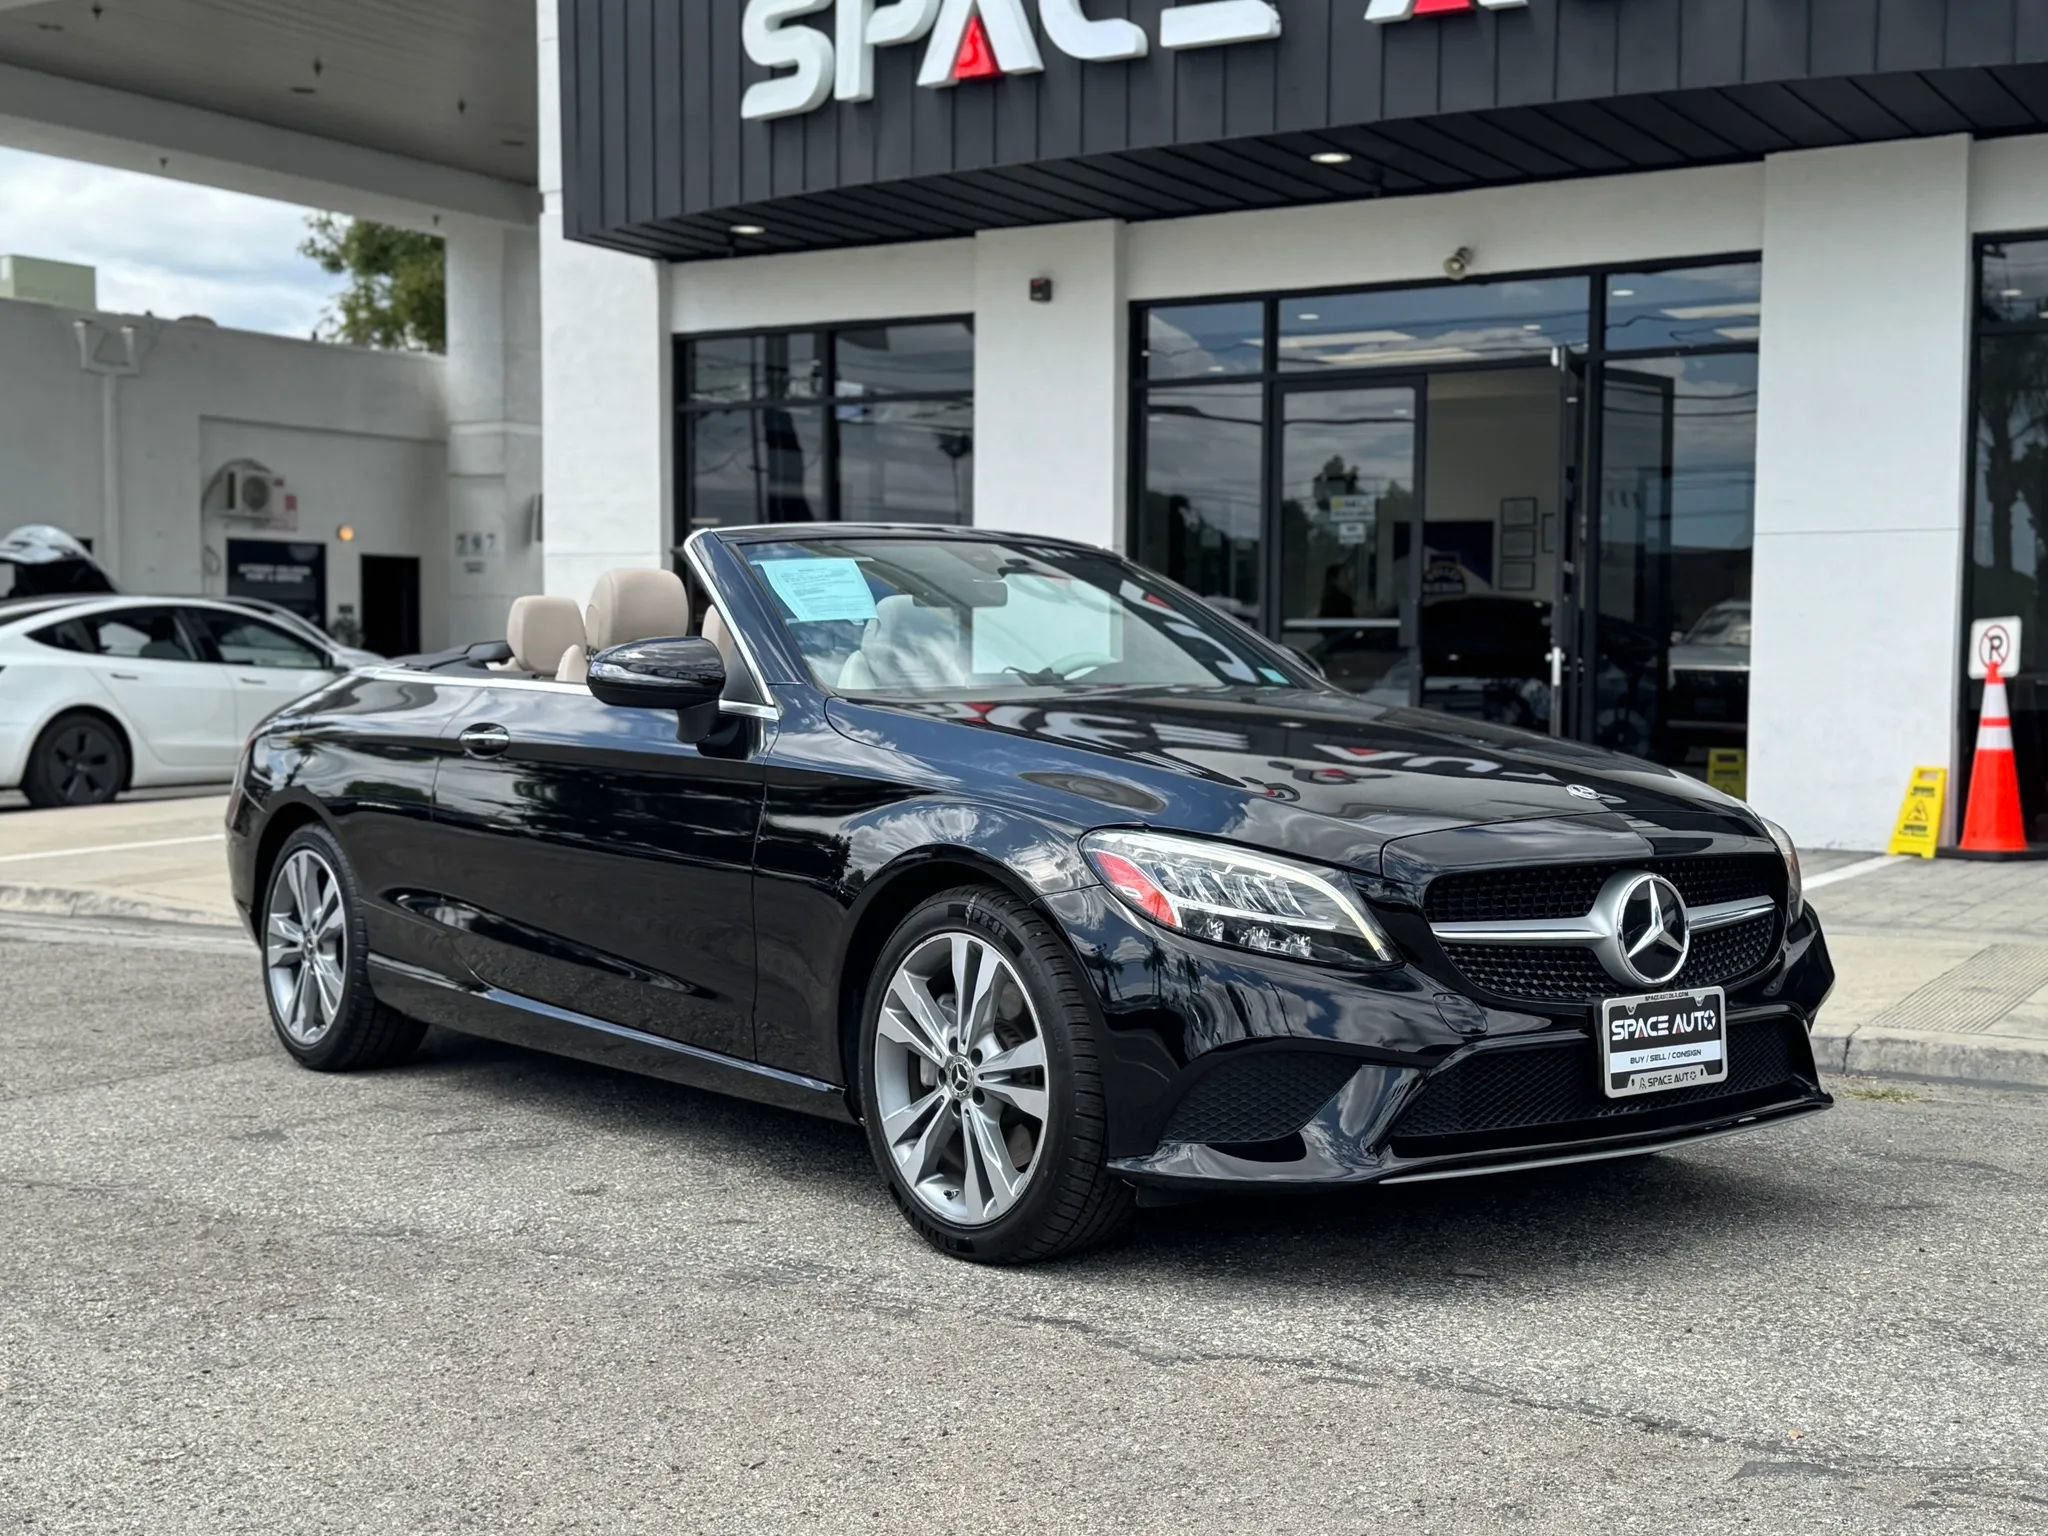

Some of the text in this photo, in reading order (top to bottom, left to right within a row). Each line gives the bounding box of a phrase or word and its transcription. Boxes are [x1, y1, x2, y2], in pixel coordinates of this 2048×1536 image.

[1611, 1009, 1716, 1040] SPACE AUTO
[1630, 1056, 1645, 1064] BUY
[1649, 1053, 1666, 1062] SELL
[1671, 1049, 1702, 1059] CONSIGN
[1648, 1071, 1697, 1087] SPACE AUTO
